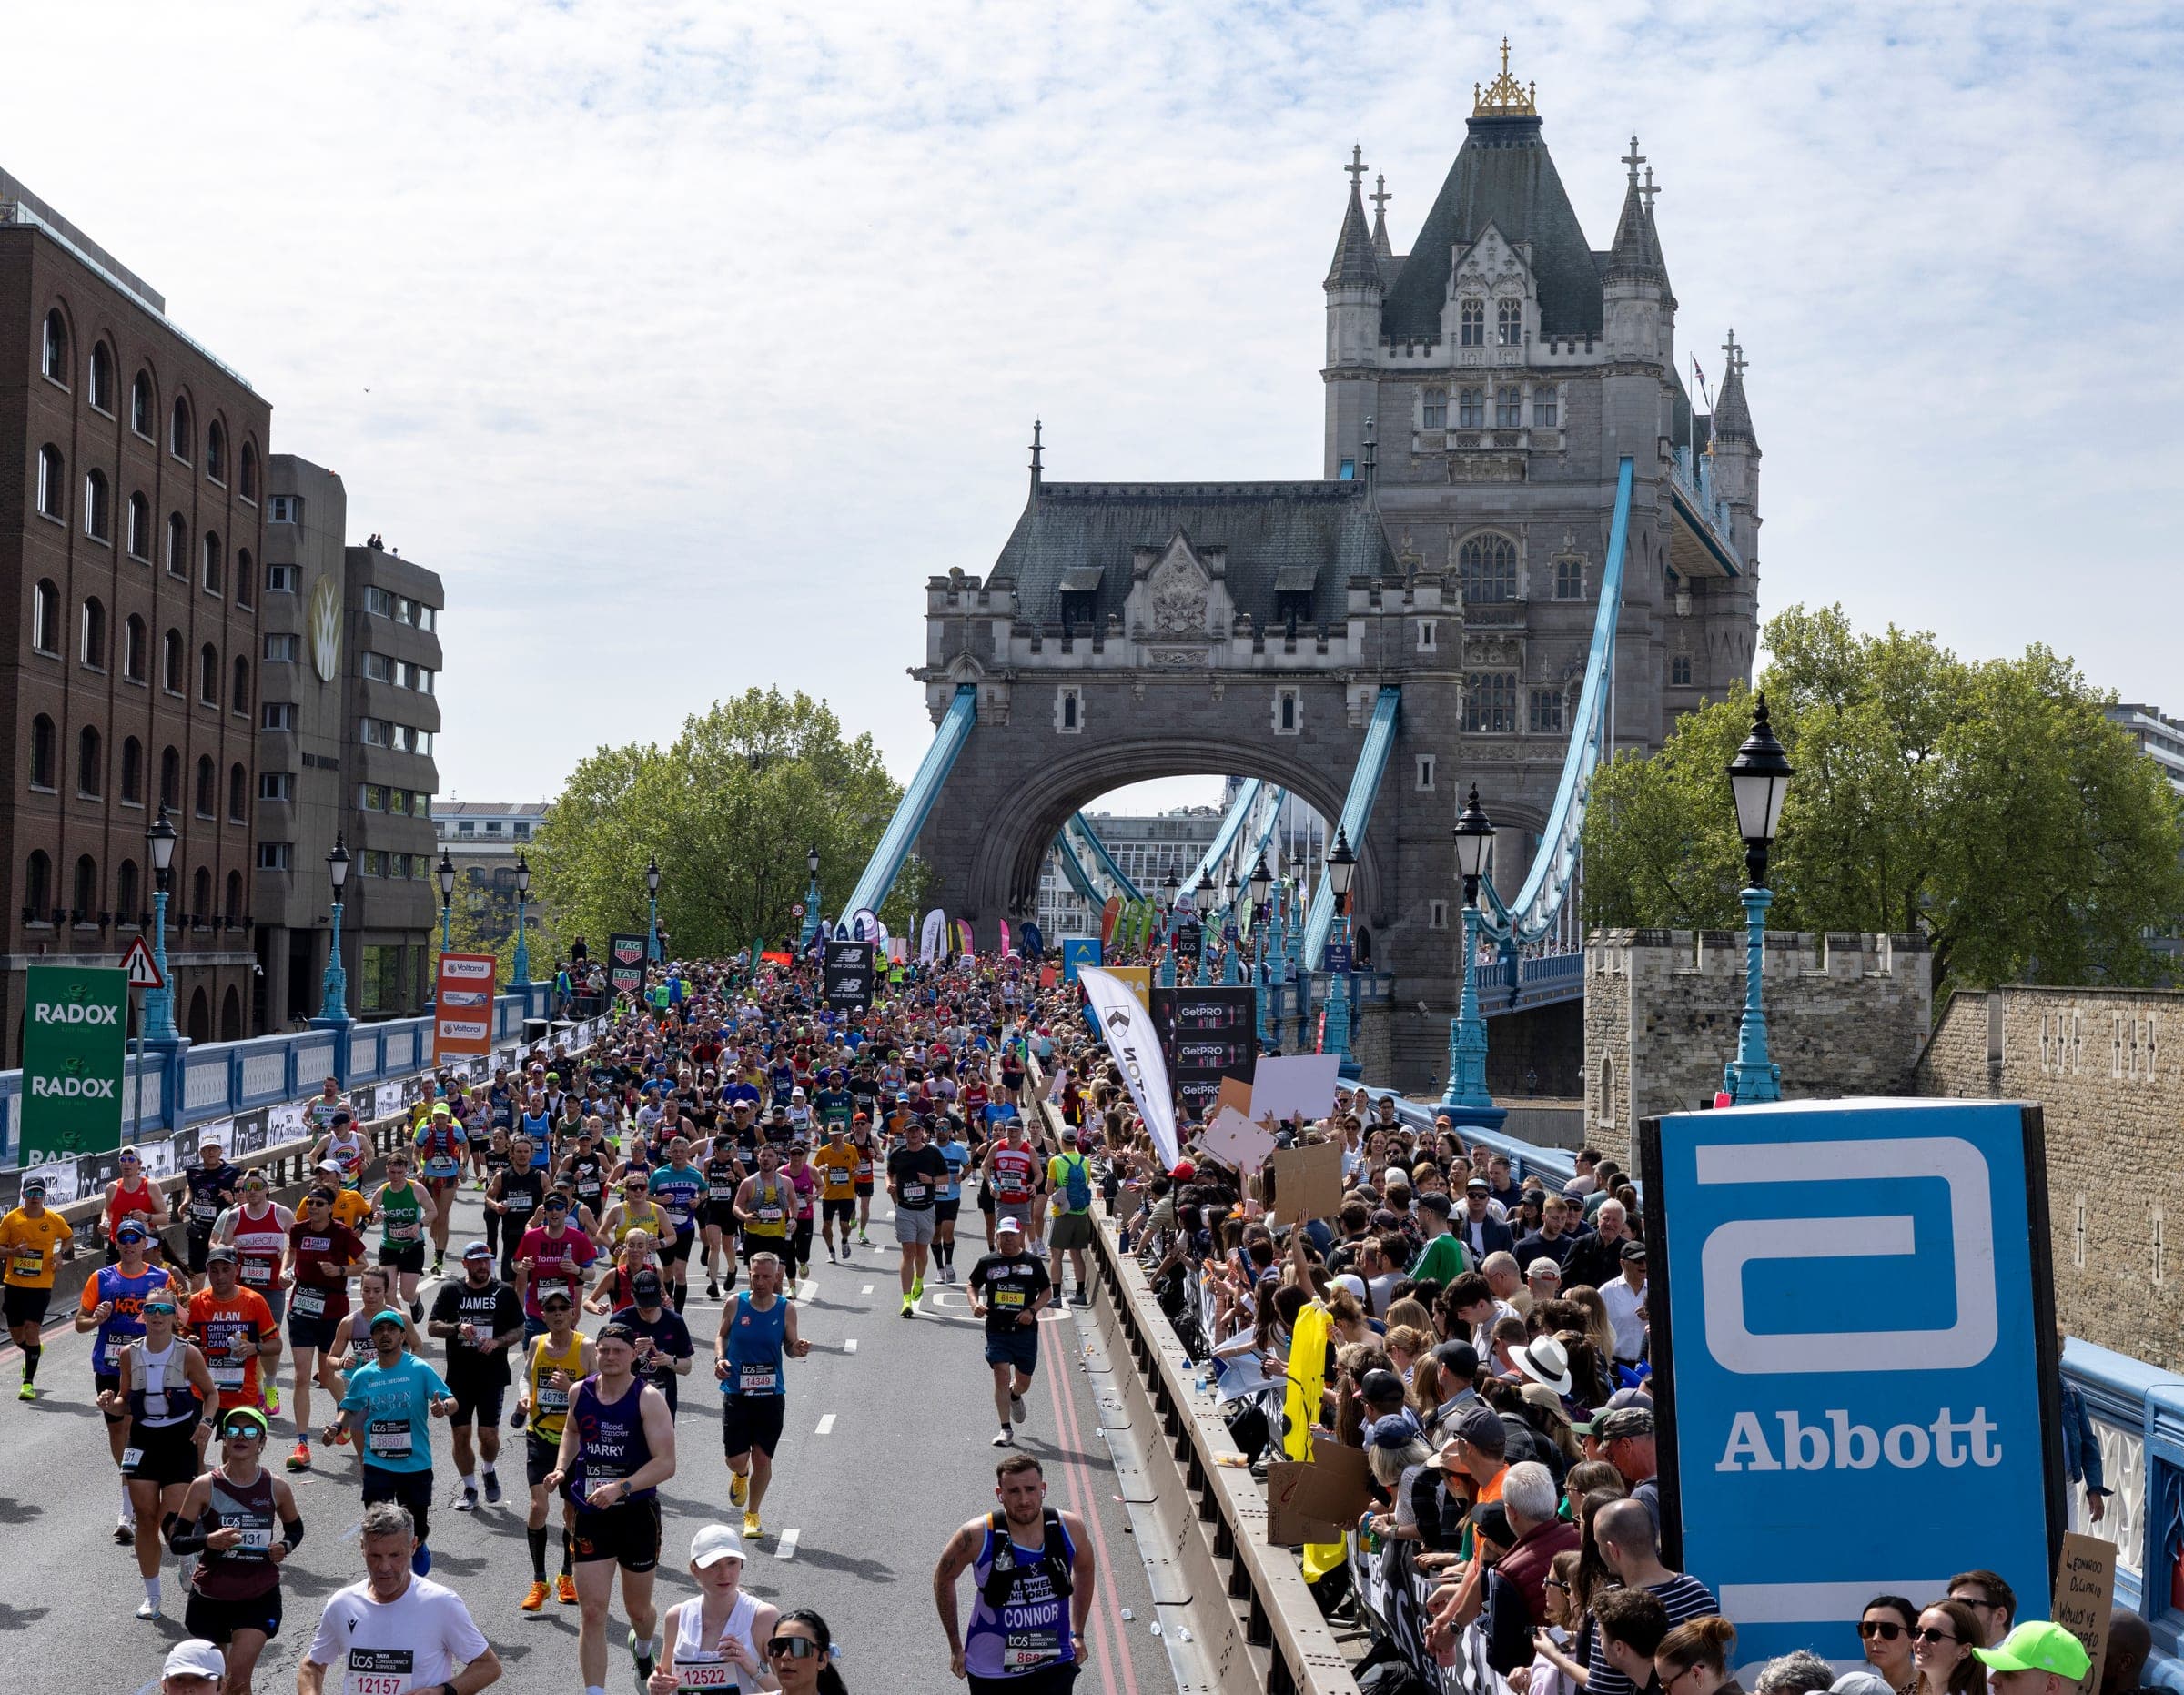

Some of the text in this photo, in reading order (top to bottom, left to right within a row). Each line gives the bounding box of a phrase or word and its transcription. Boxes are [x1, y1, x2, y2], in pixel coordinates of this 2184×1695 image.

[618, 942, 641, 950] TAG
[457, 961, 484, 972] Voltarol
[615, 970, 638, 978] TAG
[35, 1003, 118, 1024] RADOX
[1181, 1007, 1222, 1016] GetPRO
[453, 1024, 480, 1033] Voltarol
[1182, 1046, 1223, 1055] GetPRO
[31, 1075, 115, 1098] RADOX
[460, 1297, 496, 1310] JAMES
[212, 1311, 240, 1321] ALAN
[207, 1324, 249, 1332] CHILDREN
[108, 1333, 122, 1344] tcs
[209, 1357, 223, 1367] tcs
[743, 1365, 756, 1374] tcs
[745, 1377, 771, 1387] 14349
[372, 1423, 386, 1432] tcs
[601, 1421, 623, 1431] Blood
[601, 1428, 628, 1438] cancer
[377, 1437, 405, 1448] 38607
[602, 1436, 613, 1444] UK
[1715, 1407, 2002, 1472] Abbott
[587, 1441, 625, 1457] HARRY
[587, 1465, 601, 1476] tcs
[221, 1515, 241, 1529] tcs
[1004, 1603, 1058, 1629] CONNOR
[1009, 1634, 1028, 1647] tcs
[352, 1651, 373, 1669] tcs
[684, 1669, 726, 1685] 12522
[357, 1677, 401, 1695] 12157
